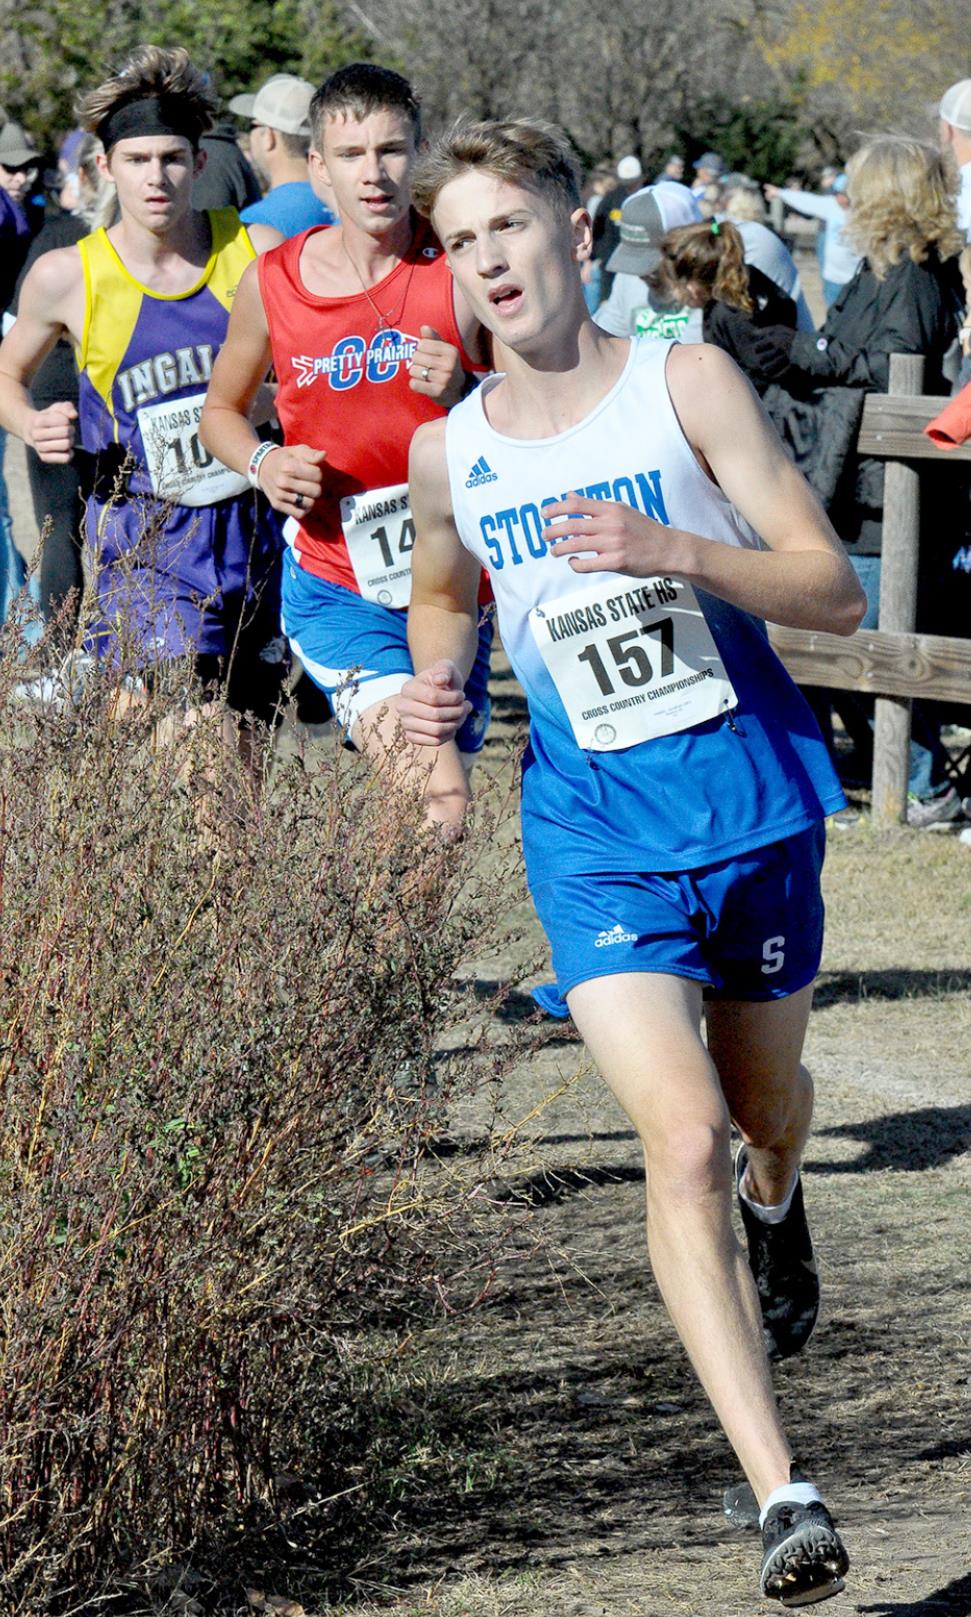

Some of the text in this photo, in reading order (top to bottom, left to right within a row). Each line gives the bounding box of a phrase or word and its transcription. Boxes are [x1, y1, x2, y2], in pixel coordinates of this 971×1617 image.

[118, 344, 225, 413] INGAL
[314, 352, 364, 375] PRETTY
[465, 472, 498, 488] adidas
[355, 500, 397, 525] KANSAS
[546, 577, 678, 642] KANSAS STATE HS
[577, 617, 675, 697] 157
[581, 705, 609, 721] CROSS
[609, 694, 647, 713] COUNTRY
[647, 668, 715, 701] CHAMPIONSHIPS
[594, 931, 638, 948] adidas
[761, 935, 786, 974] S
